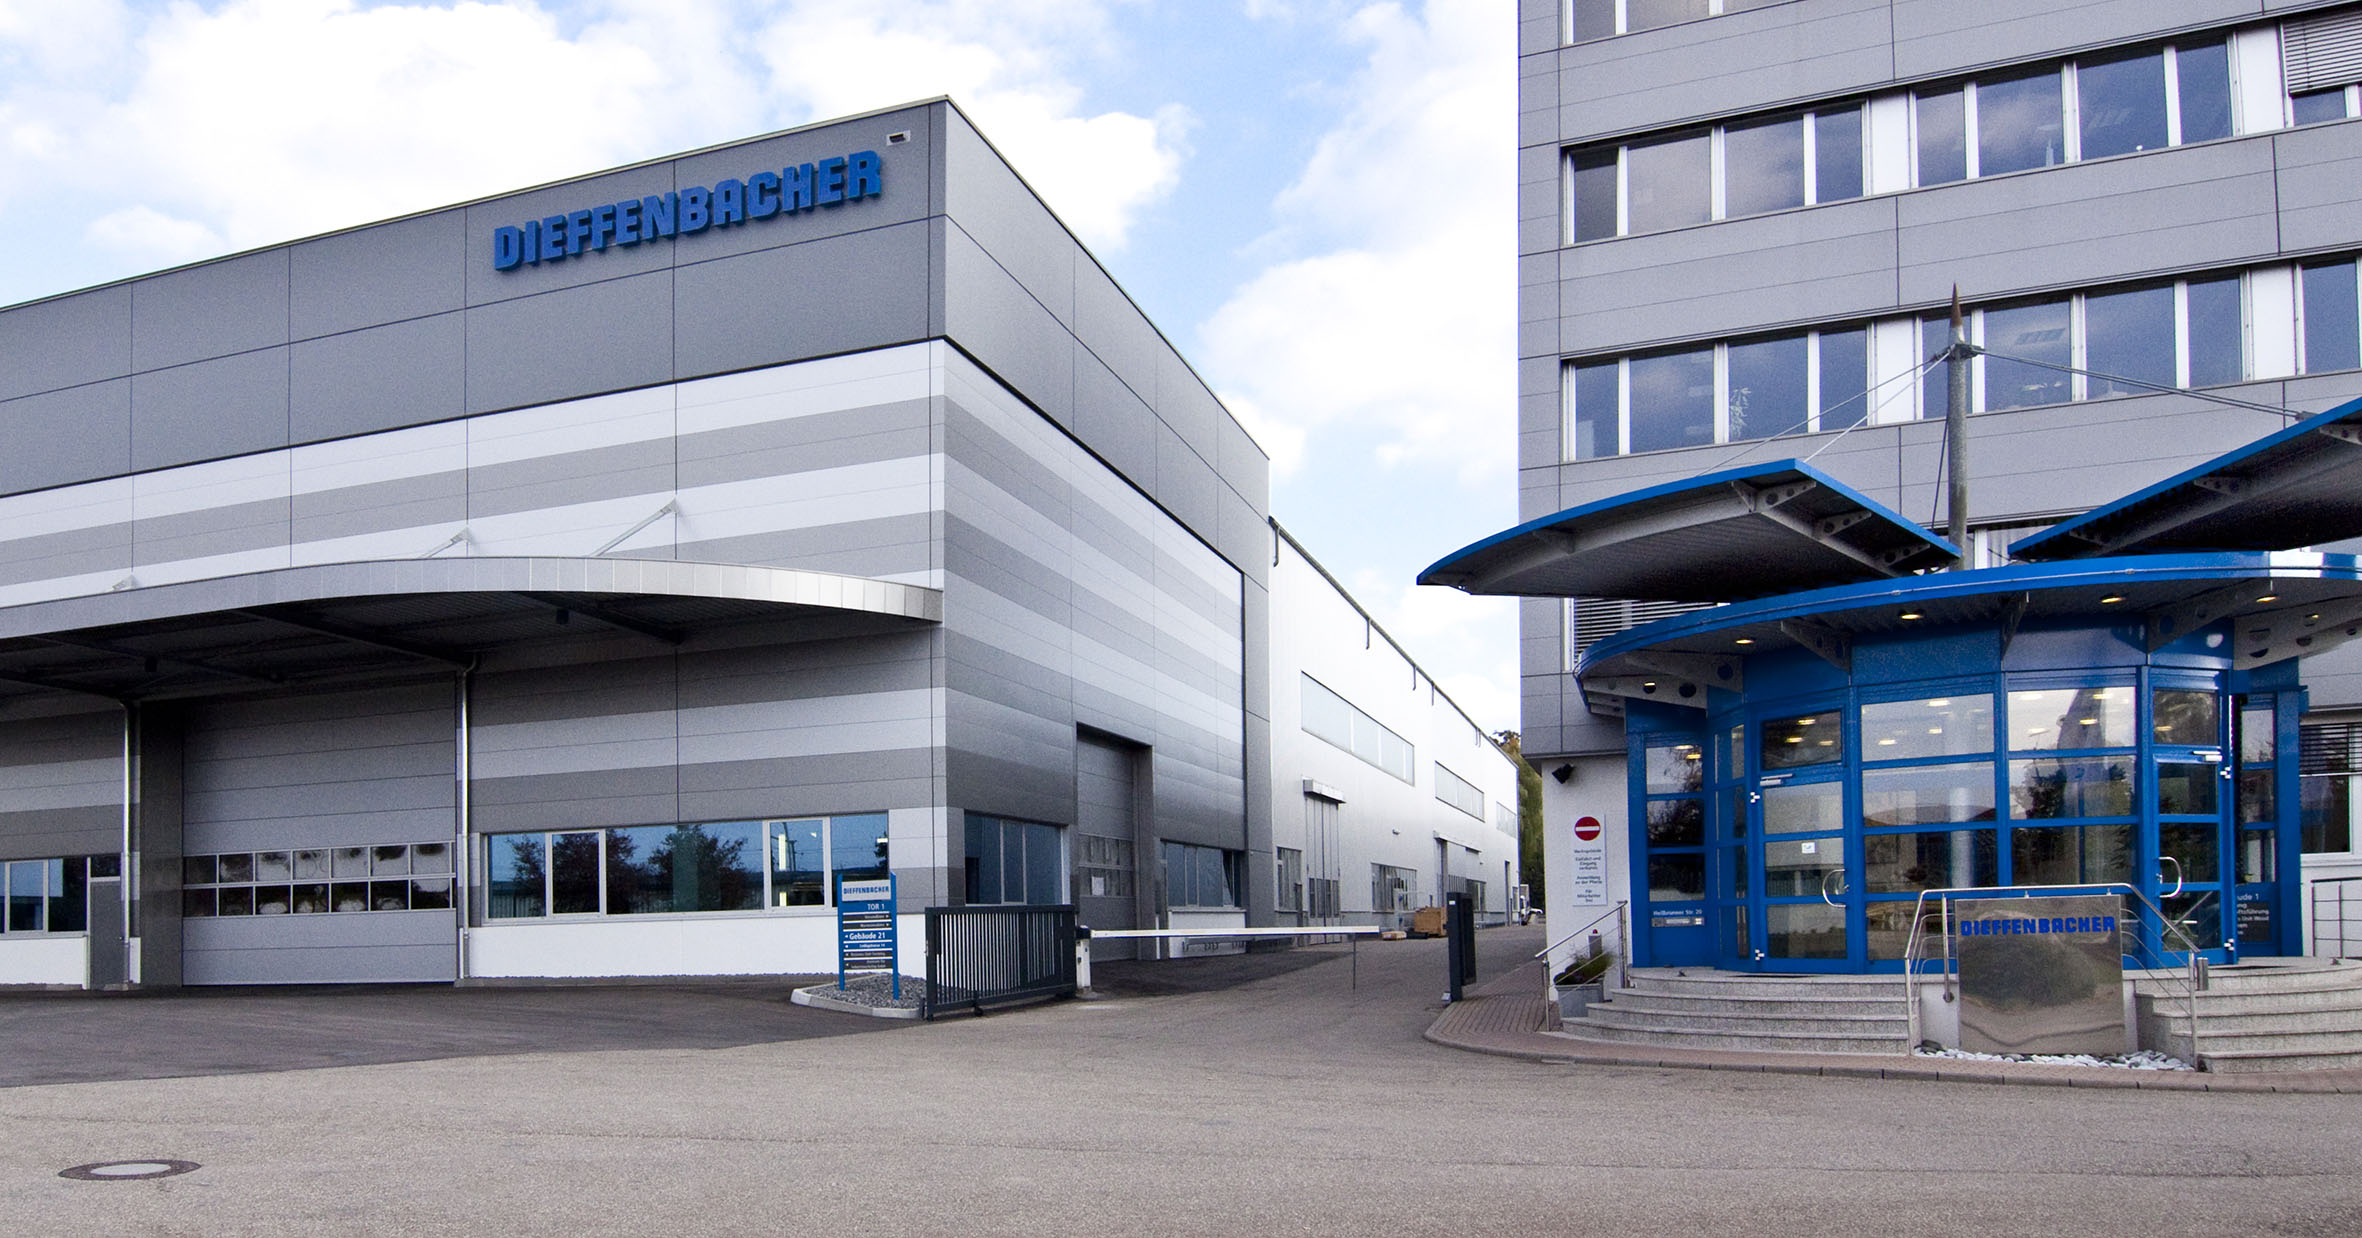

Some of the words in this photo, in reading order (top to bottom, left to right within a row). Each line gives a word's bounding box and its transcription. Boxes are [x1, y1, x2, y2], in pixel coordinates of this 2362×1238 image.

[494, 150, 883, 271] DIEFFENBACHER
[843, 886, 889, 895] DIEFFENBACHER
[1960, 916, 2115, 936] DIEFFENBACHER
[849, 932, 877, 940] Gebäude
[878, 932, 886, 940] 21
